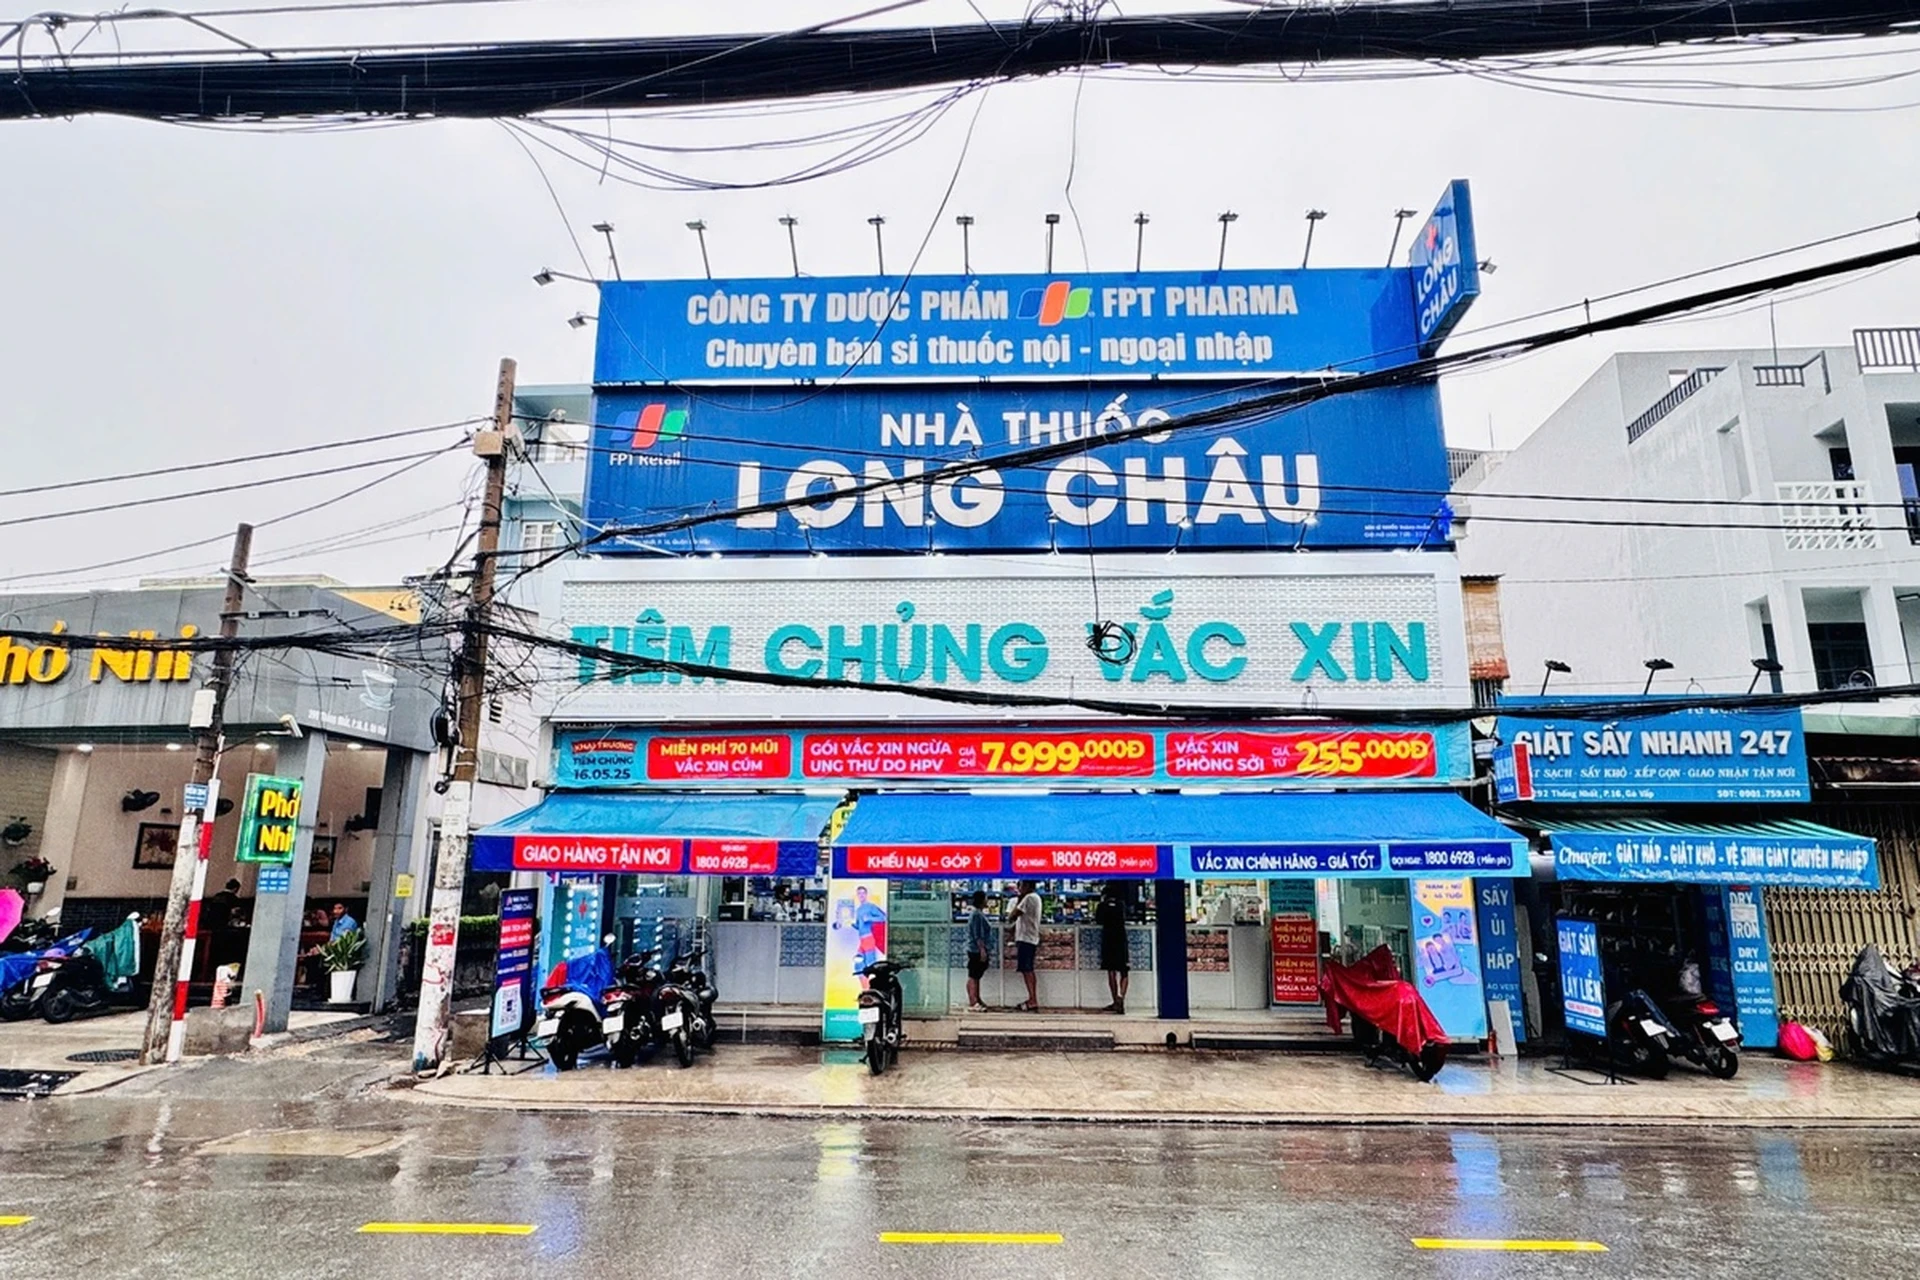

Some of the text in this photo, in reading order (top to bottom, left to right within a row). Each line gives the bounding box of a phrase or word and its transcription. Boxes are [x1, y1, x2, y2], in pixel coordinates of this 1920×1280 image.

[1417, 237, 1454, 304] LONG
[687, 280, 1299, 327] CÔNG TY DƯỢC PHẨM FPT PHARMA
[1421, 267, 1458, 335] CHÂU
[706, 337, 817, 369] Chuyên
[826, 337, 883, 366] bán
[927, 331, 1014, 364] thuốc
[1023, 334, 1070, 368] nội
[1101, 333, 1186, 367] ngoại
[1195, 330, 1273, 366] nhập
[881, 393, 1173, 447] NHÀ THUỐC
[736, 437, 1321, 529] LONG CHÂU
[569, 588, 1429, 685] TIÊM CHỦNG VẮC XIN
[90, 623, 200, 682] Nhi
[661, 738, 779, 755] MIỄN PHÍ 70 MŨI
[810, 738, 952, 756] GÓI VẮC XIN NGỪA
[1175, 736, 1239, 754] VẮC XIN
[1515, 721, 1792, 761] GIẶT SẤY NHANH 247
[598, 754, 635, 766] CHỦNG
[706, 760, 730, 772] XIN
[732, 758, 763, 772] CÚM
[810, 758, 943, 772] UNG THƯ DO HPV
[1175, 755, 1265, 771] PHÒNG SỞI
[574, 769, 632, 780] 16.05.25
[1543, 768, 1573, 780] SẠCH
[1580, 765, 1601, 778] SẤY
[1634, 765, 1656, 778] XẾP
[1658, 768, 1680, 780] GỌN
[1687, 768, 1715, 778] GIAO
[1718, 766, 1750, 779] NHẬN
[1753, 766, 1775, 779] TẬN
[1776, 767, 1796, 778] NƠI
[259, 824, 293, 852] Nhi
[523, 841, 671, 868] GIAO HÀNG TẬN NƠI
[696, 856, 720, 869] 1800
[721, 856, 749, 869] 6928
[868, 852, 904, 868] KHIẾU
[906, 856, 929, 872] NẠI
[941, 853, 971, 869] GÓP
[974, 853, 983, 868] Ý
[1052, 851, 1081, 867] 1800
[1084, 851, 1117, 867] 6928
[1197, 851, 1223, 869] VẮC
[1225, 856, 1245, 870] XIN
[1246, 852, 1282, 870] CHÍNH
[1283, 853, 1318, 869] HÃNG
[1328, 853, 1349, 869] GIÁ
[1351, 850, 1375, 869] TỐT
[1425, 851, 1448, 865] 1800
[1450, 851, 1475, 865] 6928
[1559, 847, 1612, 867] Chuyên:
[1616, 840, 1639, 866] GIẶT
[1641, 836, 1662, 865] HẤP
[1670, 840, 1694, 867] GIẶT
[1696, 842, 1717, 866] KHÔ
[1725, 841, 1739, 869] VỆ
[1740, 846, 1764, 867] SINH
[1765, 841, 1790, 868] GIÀY
[1791, 843, 1829, 869] CHUYÊN
[1831, 845, 1870, 875] NGHIỆP
[1482, 883, 1508, 907] SẤY
[1729, 892, 1753, 904] DRY
[1491, 913, 1506, 936] ỦI
[1732, 922, 1761, 939] IRON
[1276, 934, 1290, 943] 70
[1486, 947, 1515, 970] HẤP
[1738, 947, 1759, 959] DRY
[1734, 961, 1768, 973] CLEAN
